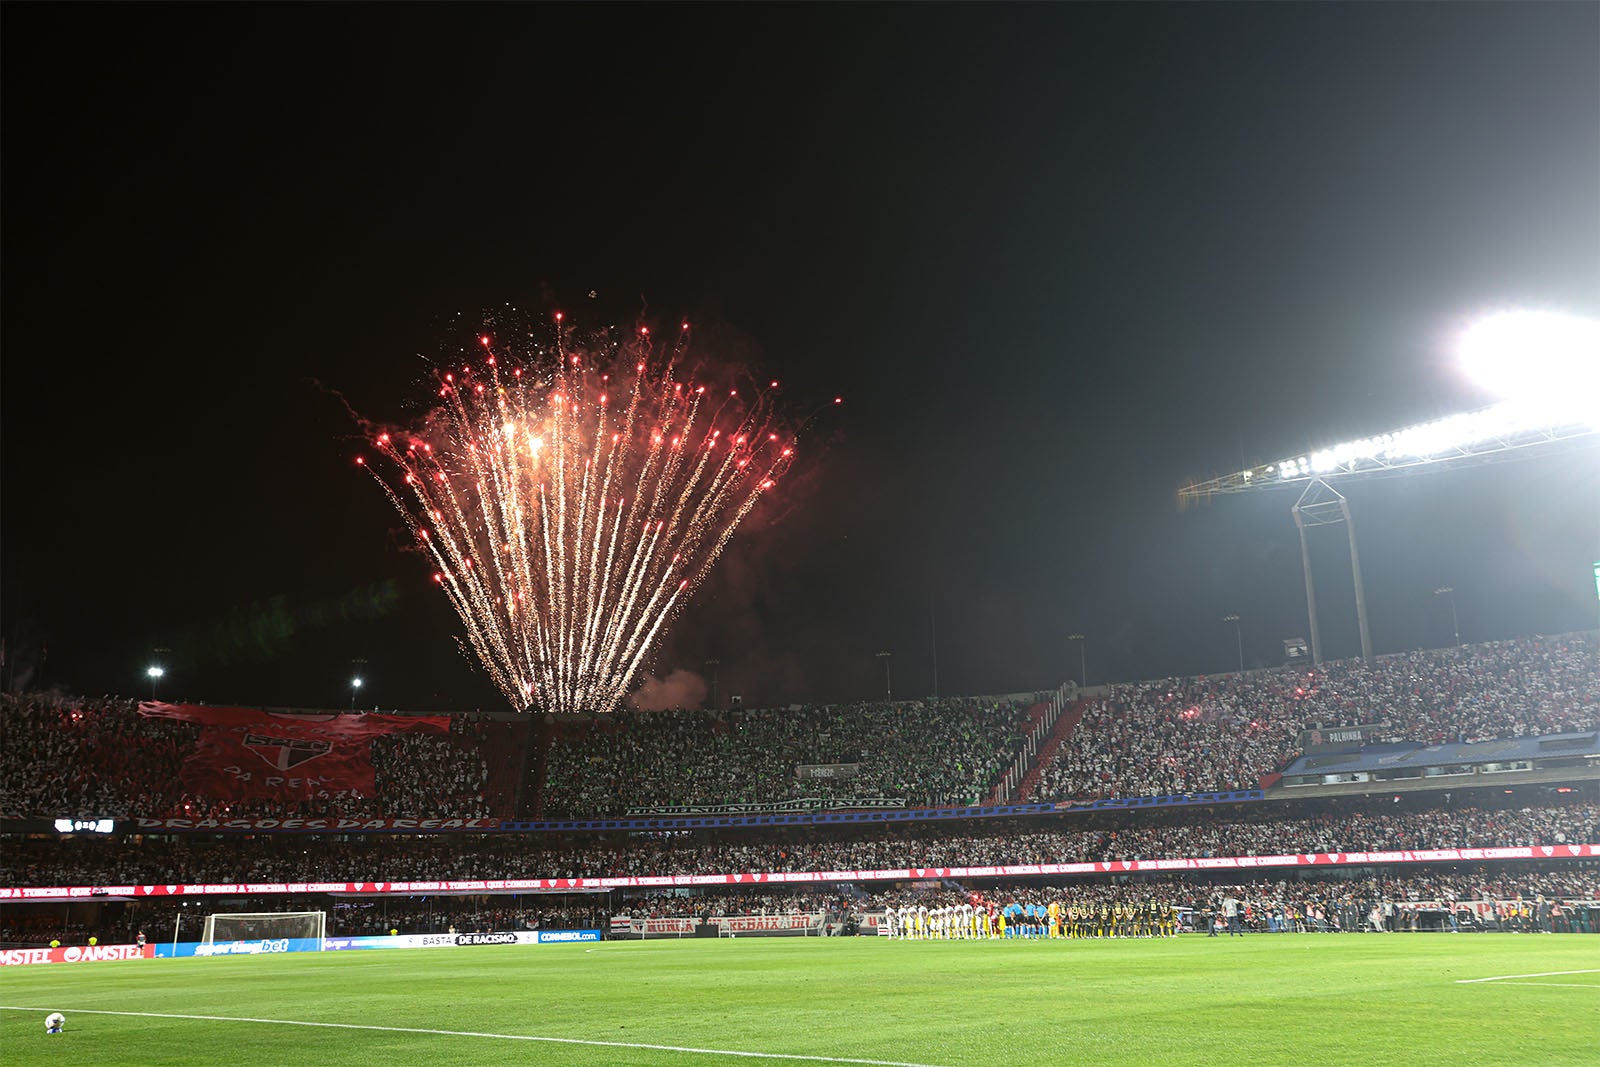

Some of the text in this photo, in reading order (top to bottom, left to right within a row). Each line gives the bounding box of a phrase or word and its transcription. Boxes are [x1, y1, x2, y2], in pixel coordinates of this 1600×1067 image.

[223, 765, 336, 789] DA REAL
[695, 804, 729, 814] SUR
[735, 799, 810, 813] SIEMPRE
[810, 798, 903, 810] PRESENTES
[337, 818, 386, 829] DA
[391, 818, 484, 829] REAL
[1405, 851, 1413, 861] A
[1414, 849, 1460, 861] TORCIDA
[1461, 848, 1484, 860] QUE
[1189, 859, 1196, 868] A
[1197, 858, 1237, 867] TORCIDA
[1238, 857, 1257, 867] QUE
[814, 872, 821, 880] A
[822, 871, 857, 880] TORCIDA
[858, 870, 874, 880] QUE
[996, 866, 1003, 875] A
[1004, 865, 1040, 874] TORCIDA
[1041, 864, 1059, 874] QUE
[440, 882, 447, 890] A
[449, 881, 486, 890] TORCIDA
[487, 880, 504, 890] QUE
[630, 877, 637, 886] A
[638, 876, 673, 885] TORCIDA
[675, 876, 692, 885] QUE
[70, 887, 91, 897] QUE
[238, 884, 245, 893] A
[247, 884, 287, 893] TORCIDA
[288, 884, 307, 893] QUE
[645, 917, 694, 932] NUNCA
[728, 915, 810, 931] REBAIXADO
[422, 936, 452, 946] BASTA
[458, 935, 472, 945] DE
[82, 944, 145, 961] AMSTEL
[194, 938, 289, 956] sportingbet
[0, 948, 52, 965] MSTEL
